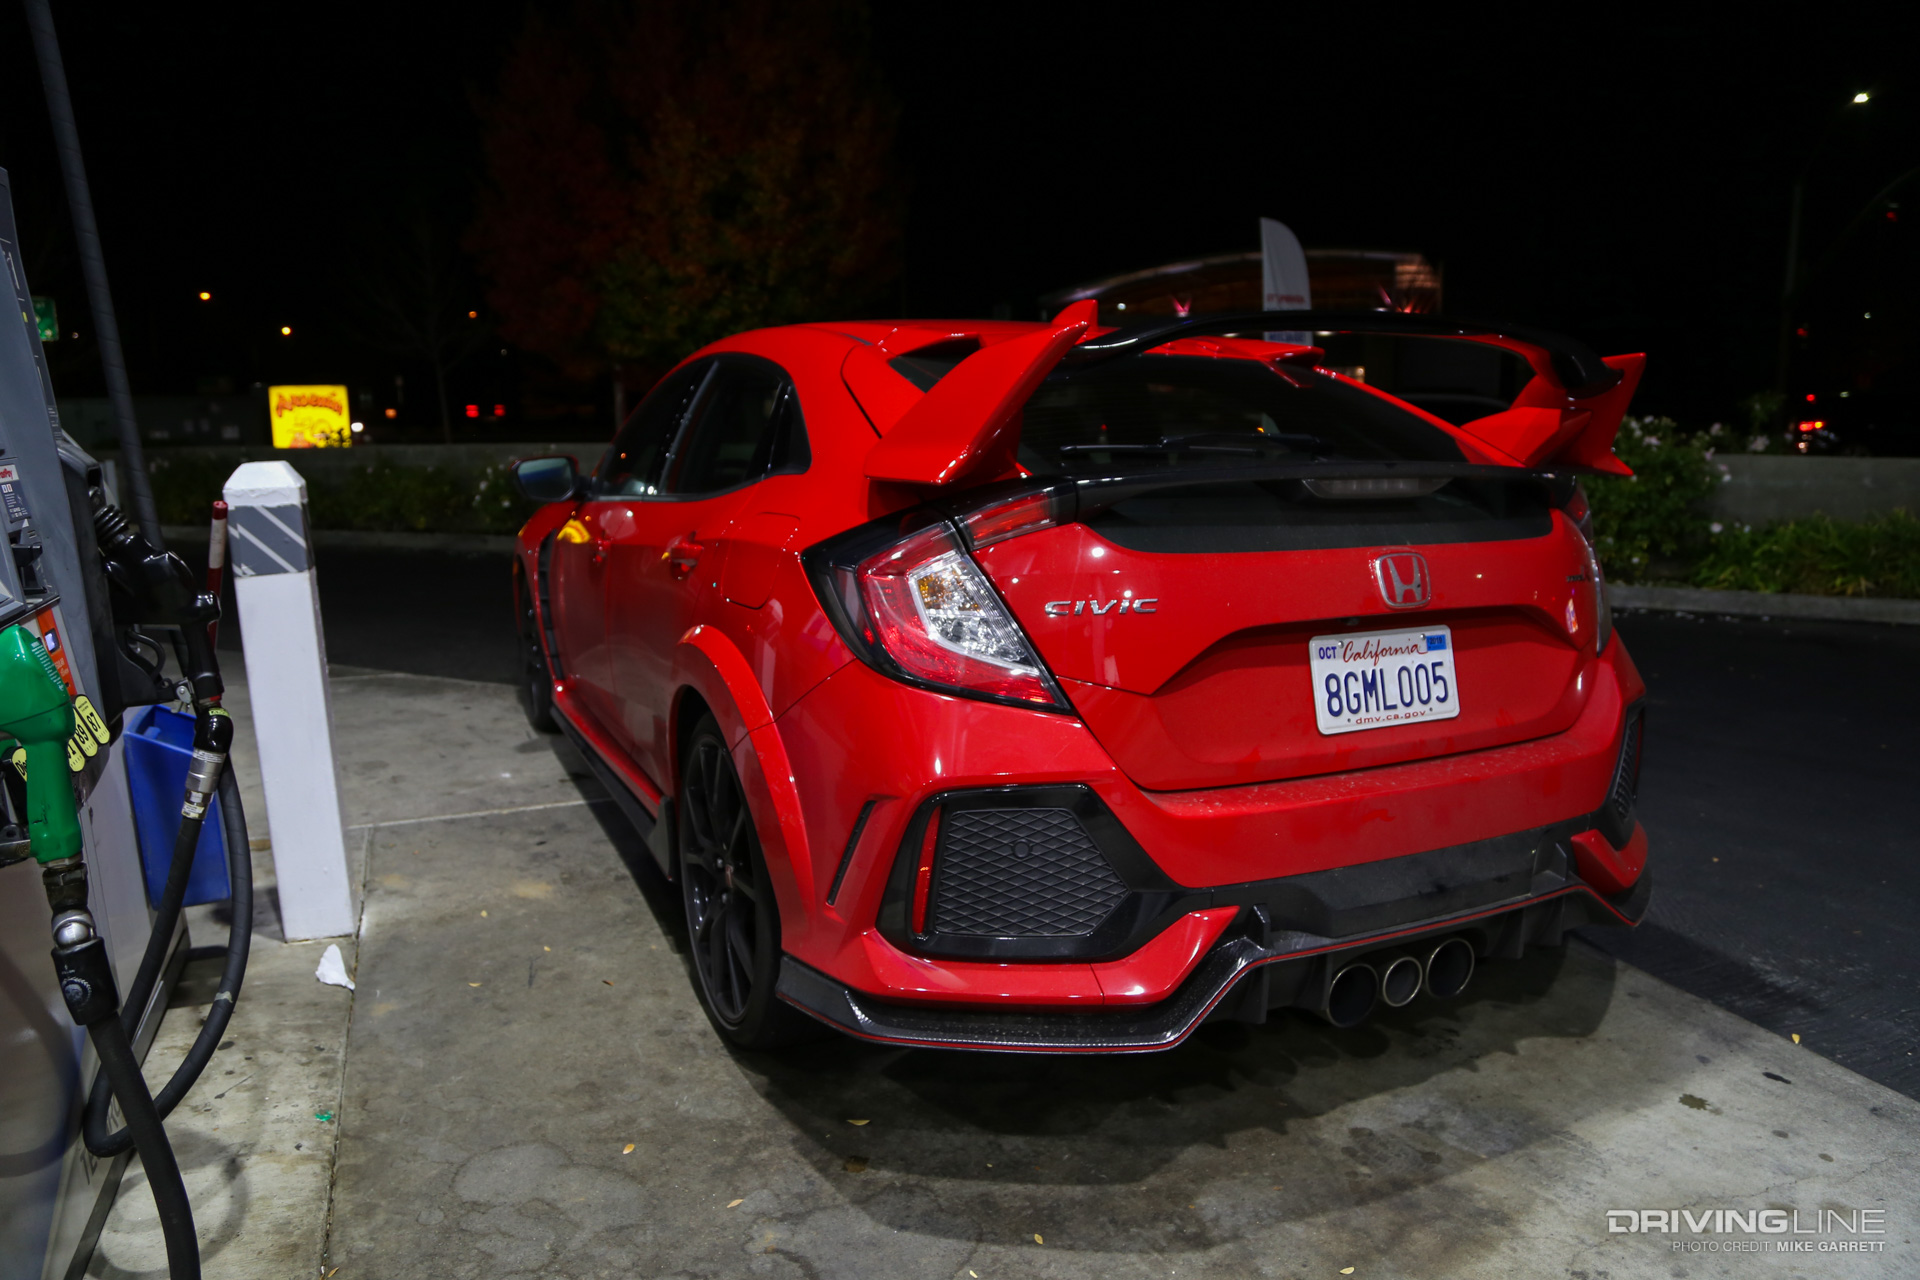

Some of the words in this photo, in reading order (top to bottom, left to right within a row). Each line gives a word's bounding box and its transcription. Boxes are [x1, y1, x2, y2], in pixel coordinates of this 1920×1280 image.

[1045, 598, 1158, 616] CIVIC
[1319, 646, 1337, 660] OCT
[1343, 639, 1428, 666] California
[1325, 661, 1449, 717] 8GML005
[86, 711, 101, 733] 87
[1355, 709, 1426, 725] dmv.ca.gov
[75, 723, 89, 745] 89
